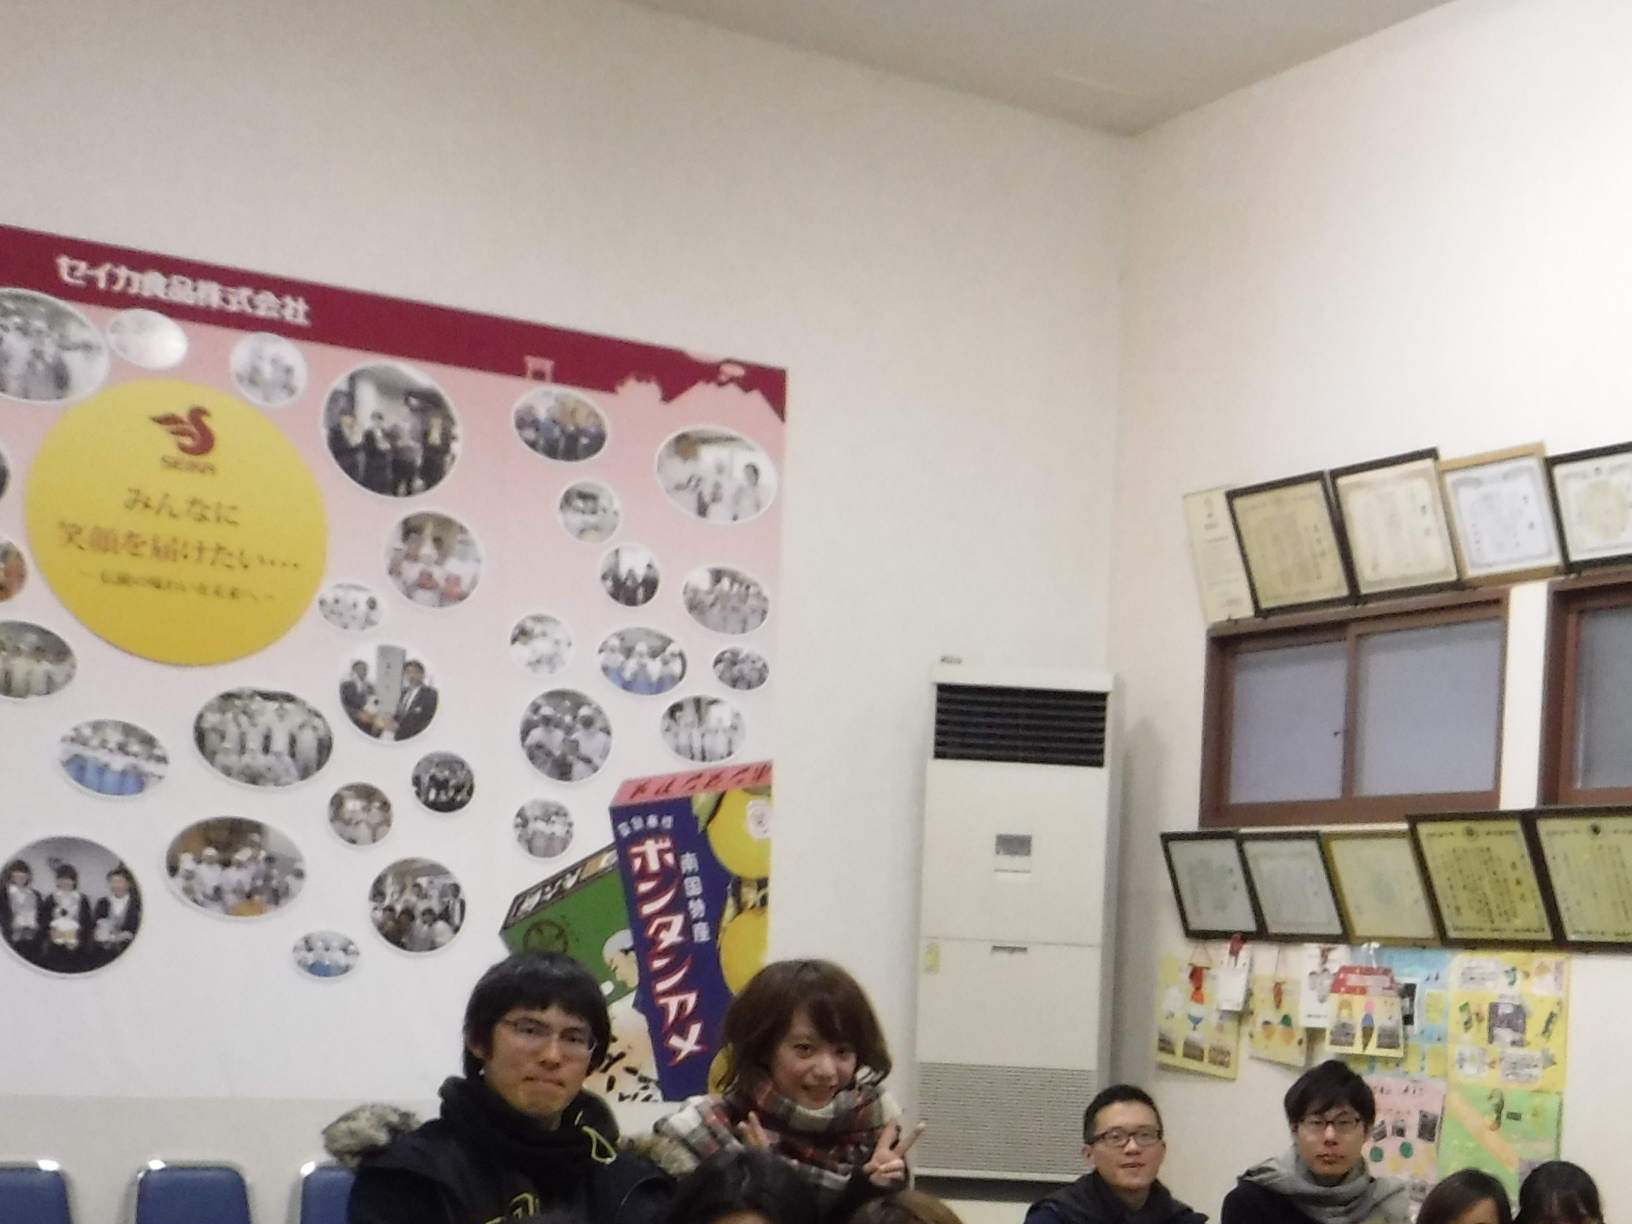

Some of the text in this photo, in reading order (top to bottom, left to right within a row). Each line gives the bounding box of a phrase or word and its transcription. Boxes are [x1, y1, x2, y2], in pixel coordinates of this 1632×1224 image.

[55, 254, 312, 327] セイカ食品株式会社
[124, 486, 240, 527] みんなに
[627, 834, 708, 1068] ボンタンアメ
